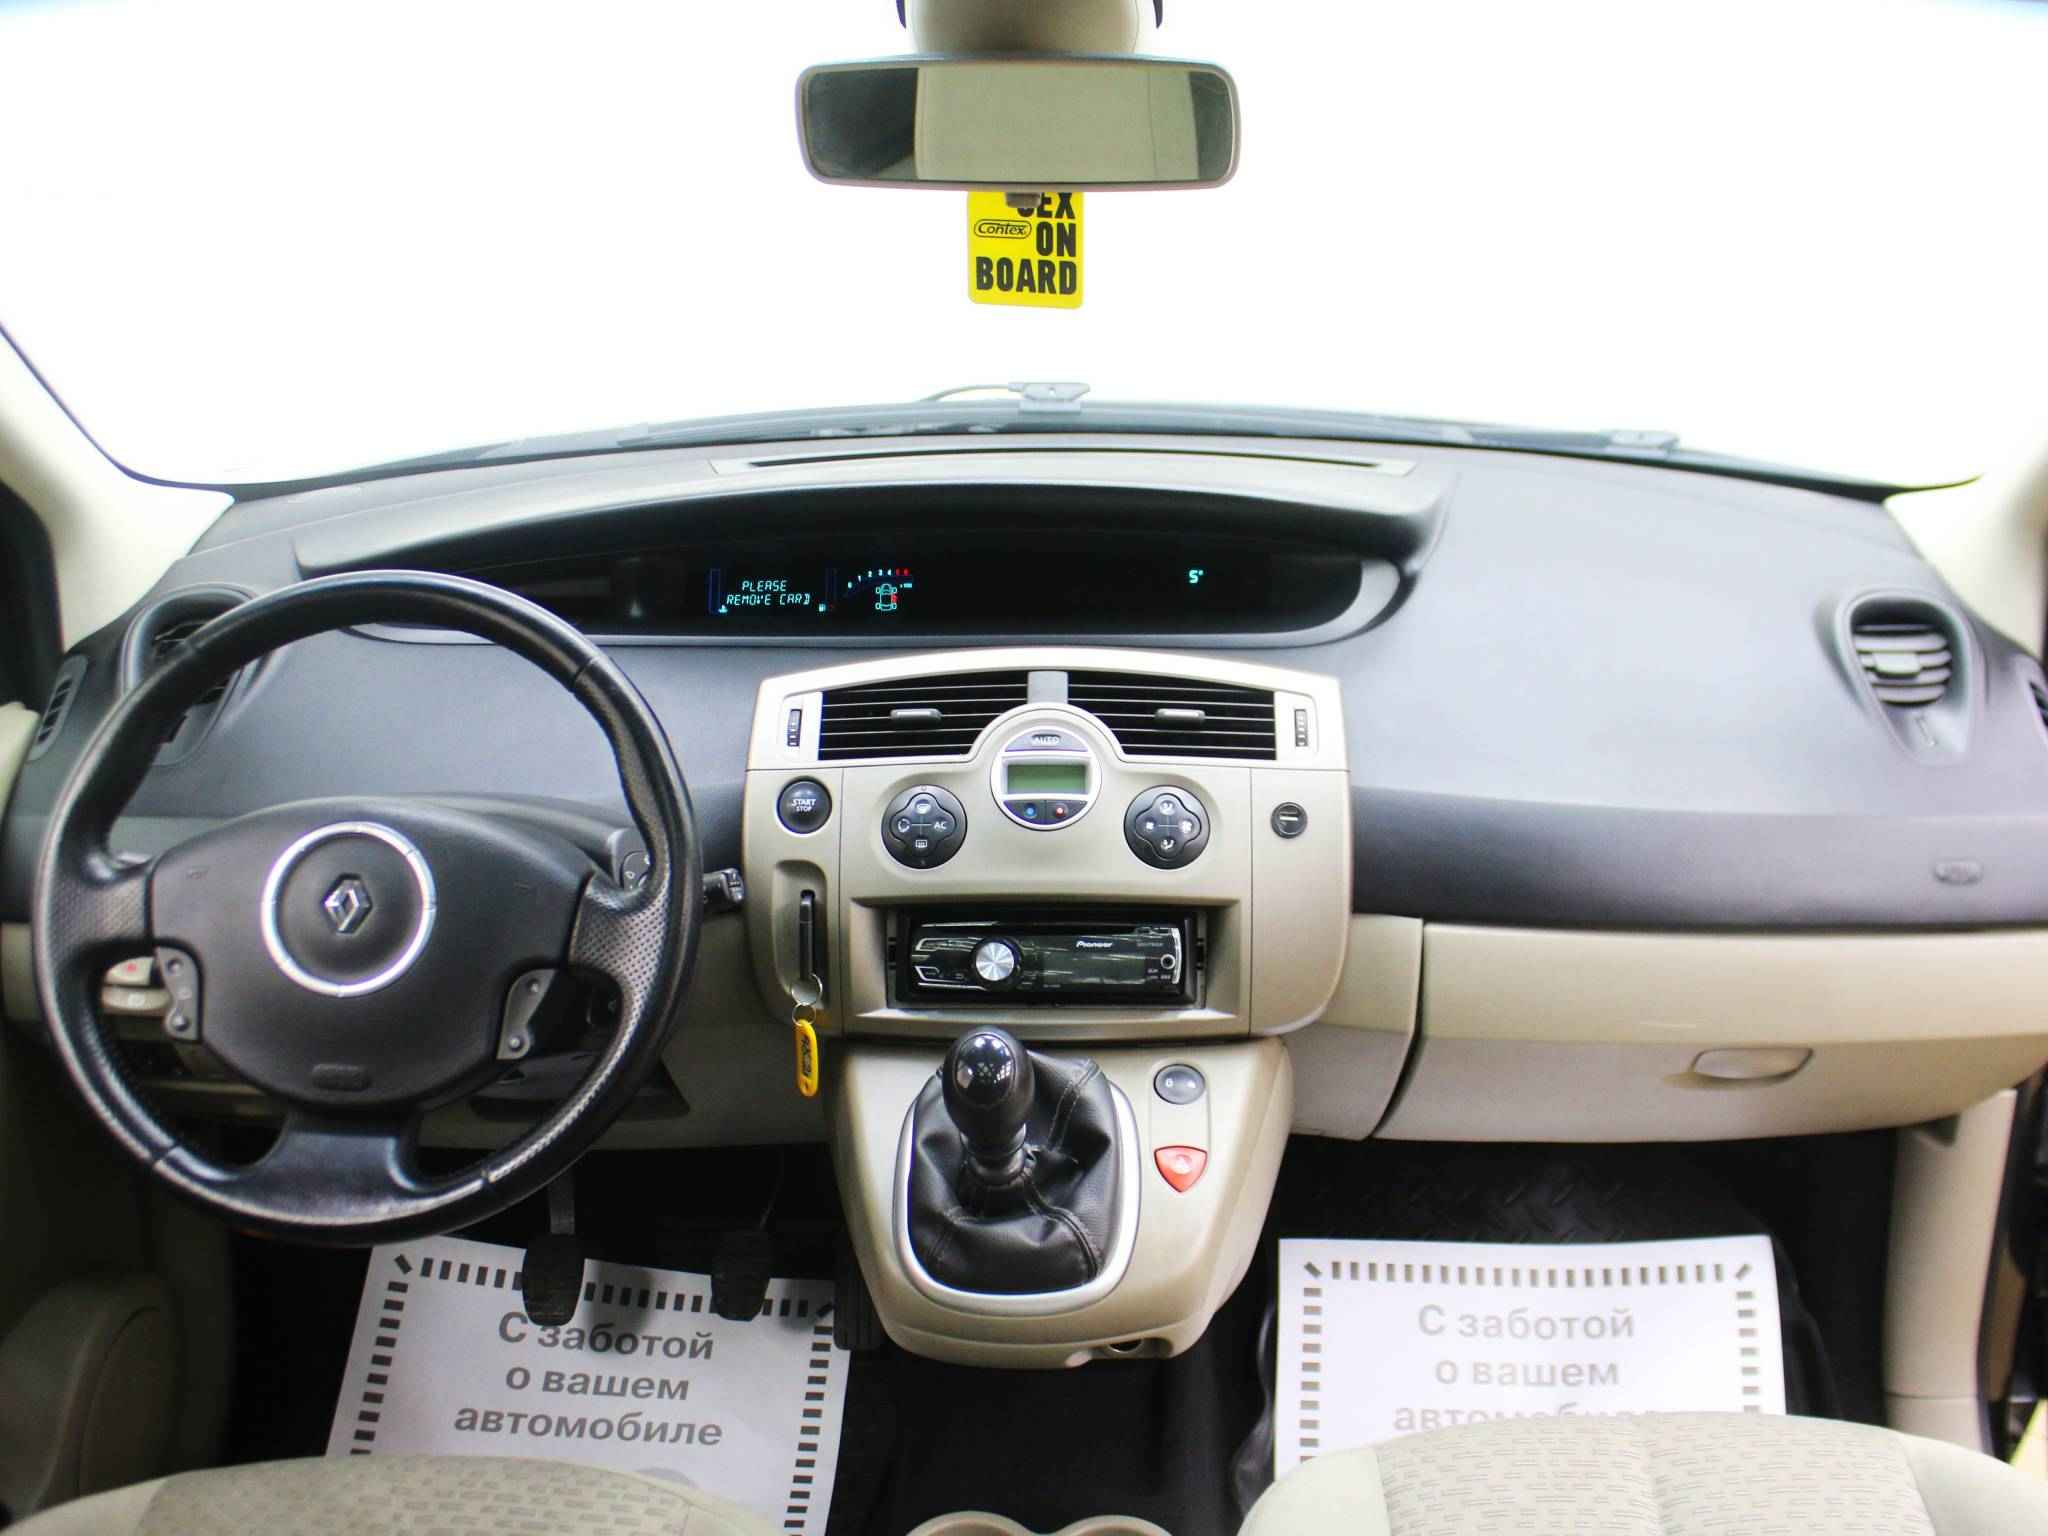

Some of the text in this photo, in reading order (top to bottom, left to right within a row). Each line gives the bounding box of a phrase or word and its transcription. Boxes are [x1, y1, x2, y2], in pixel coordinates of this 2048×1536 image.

[1036, 221, 1077, 257] ON
[976, 256, 1077, 295] BOARD
[727, 593, 811, 606] REMOVE CARD
[742, 580, 788, 592] PLEASE
[792, 798, 817, 807] START
[934, 821, 948, 830] AC
[1076, 940, 1113, 949] Pioneer
[498, 1311, 714, 1360] С заботой
[1418, 1304, 1635, 1340] С заботой
[505, 1366, 690, 1401] о вашем
[1435, 1360, 1619, 1387] о вашем
[454, 1407, 723, 1446] автомобиле
